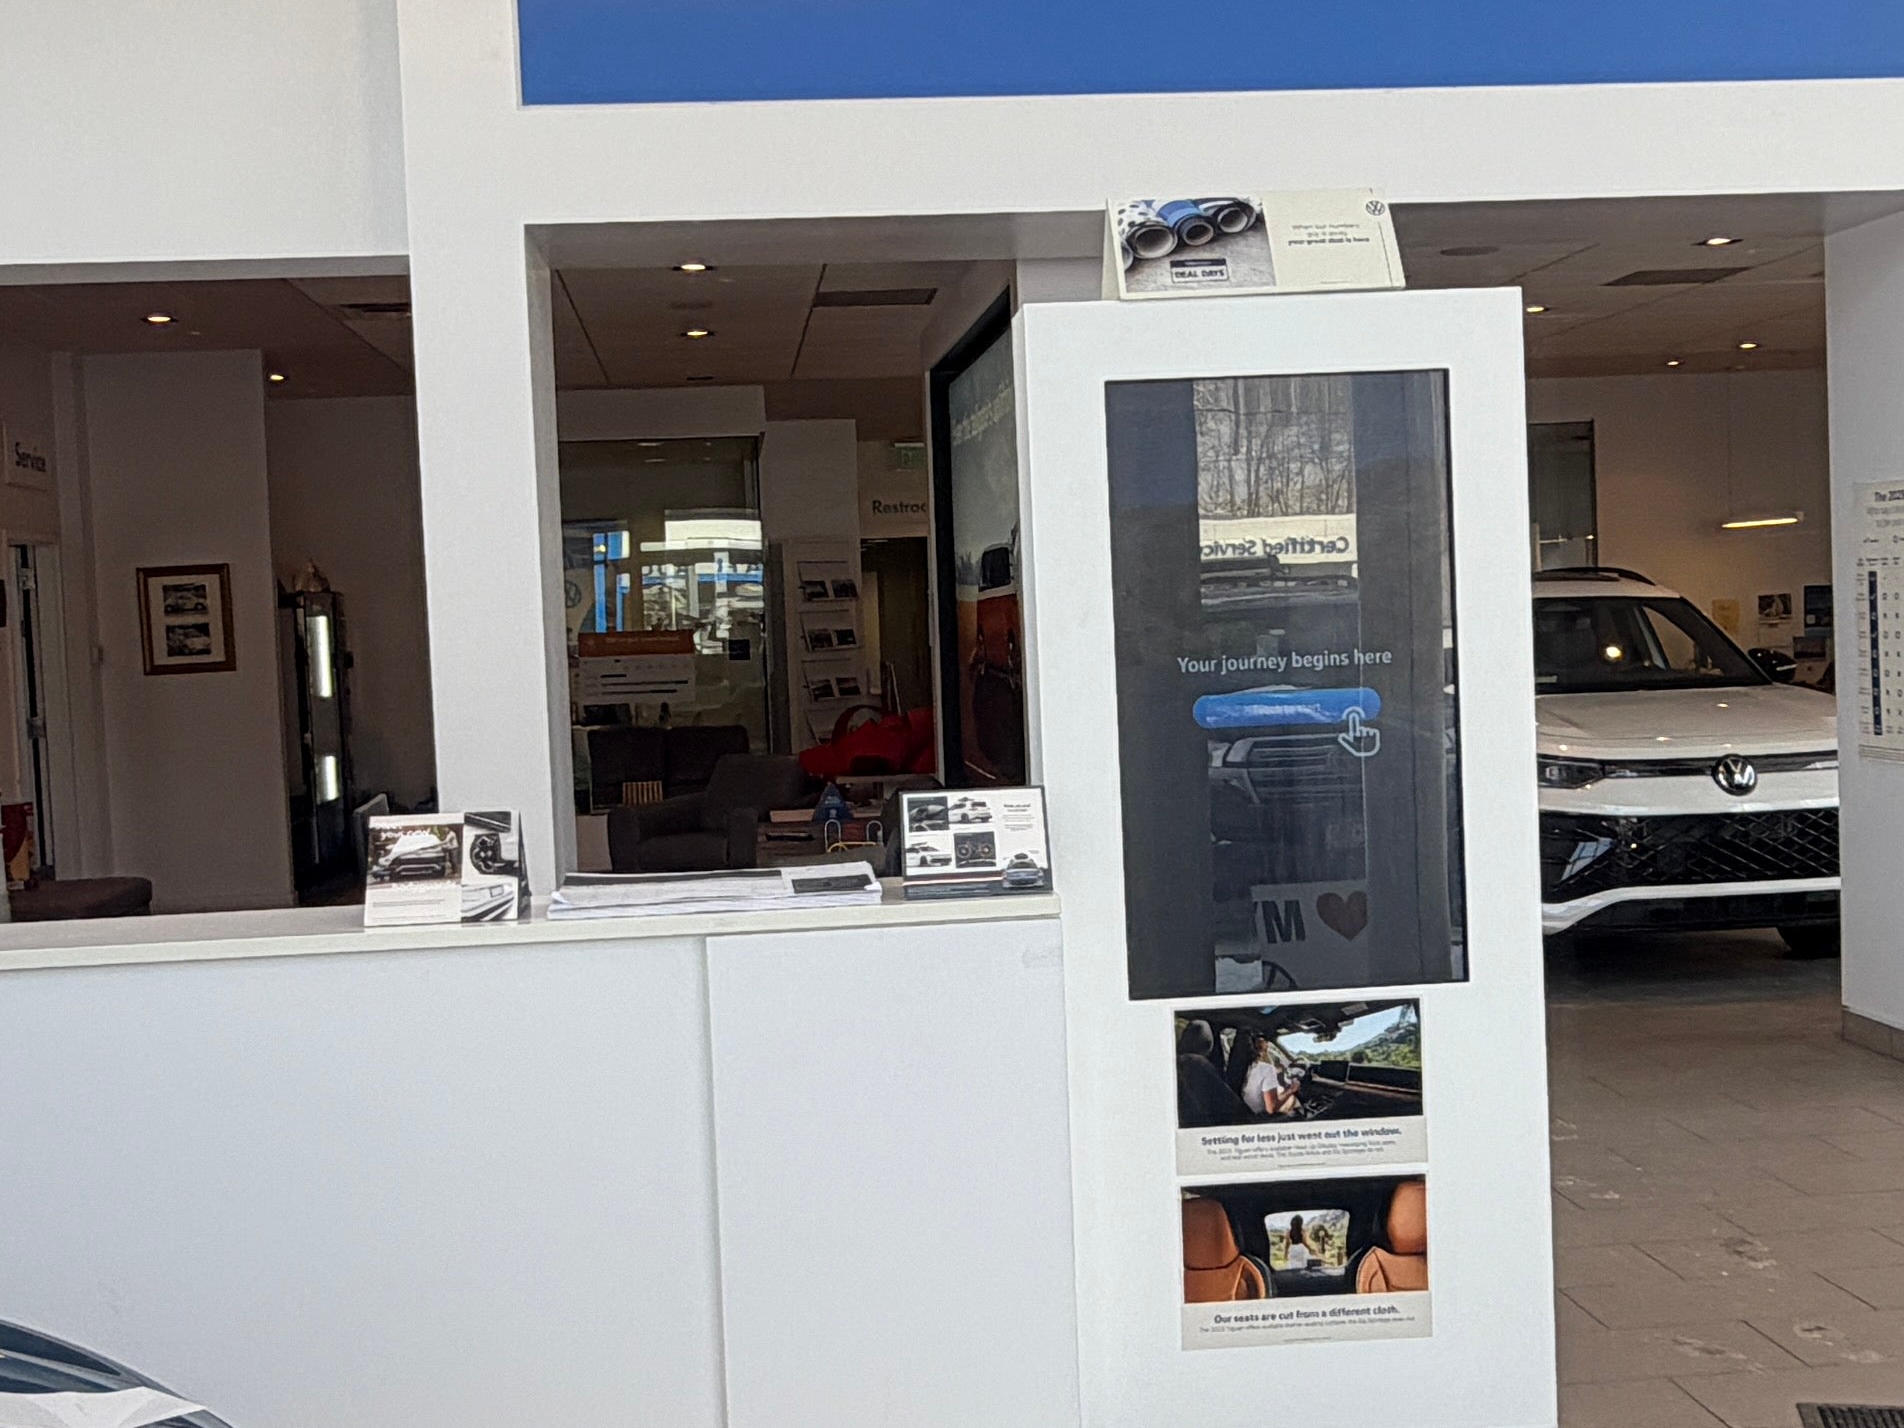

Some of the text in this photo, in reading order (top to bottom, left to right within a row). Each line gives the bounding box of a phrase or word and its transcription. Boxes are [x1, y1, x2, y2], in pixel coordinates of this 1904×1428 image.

[872, 499, 928, 515] Restroo
[1177, 648, 1392, 675] Your journey begins here
[1201, 1127, 1402, 1146] Settling for less just went out the window.
[1214, 1314, 1232, 1324] Our
[1233, 1313, 1259, 1323] seats
[1261, 1313, 1277, 1322] are
[1278, 1311, 1294, 1320] cut
[1296, 1309, 1320, 1319] from
[1329, 1306, 1371, 1317] different
[1373, 1304, 1400, 1315] cloth.
